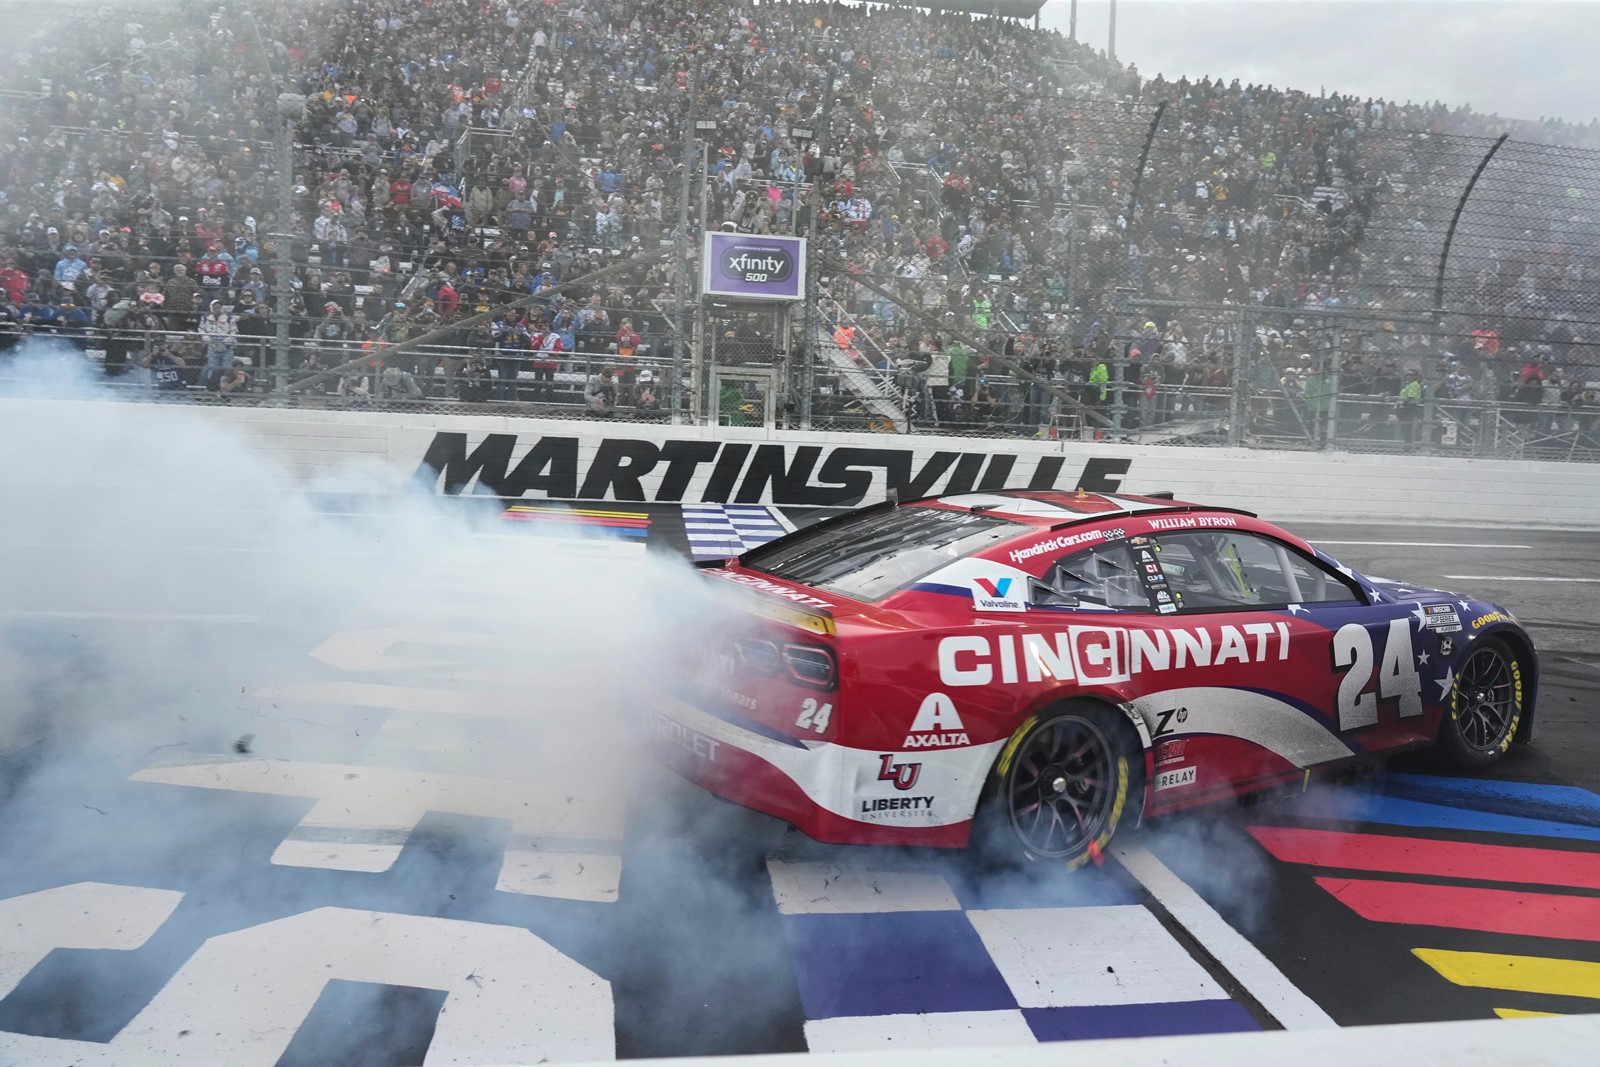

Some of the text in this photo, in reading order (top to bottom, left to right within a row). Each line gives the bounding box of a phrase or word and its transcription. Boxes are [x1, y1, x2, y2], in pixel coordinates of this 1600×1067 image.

[729, 254, 784, 273] xfinity
[745, 273, 767, 282] 500
[418, 431, 1132, 506] MARTINSVILLE
[1148, 517, 1237, 529] WILLIAM BYRON
[979, 599, 1019, 609] Valvoline
[938, 622, 1290, 687] CINCINNATI
[1333, 617, 1424, 732] 24
[795, 697, 834, 735] 24
[902, 732, 971, 748] AXALTA
[877, 754, 922, 790] LU
[1161, 770, 1195, 786] RELAY
[861, 795, 936, 813] LIBERTY
[860, 809, 935, 821] UNIVERSITY
